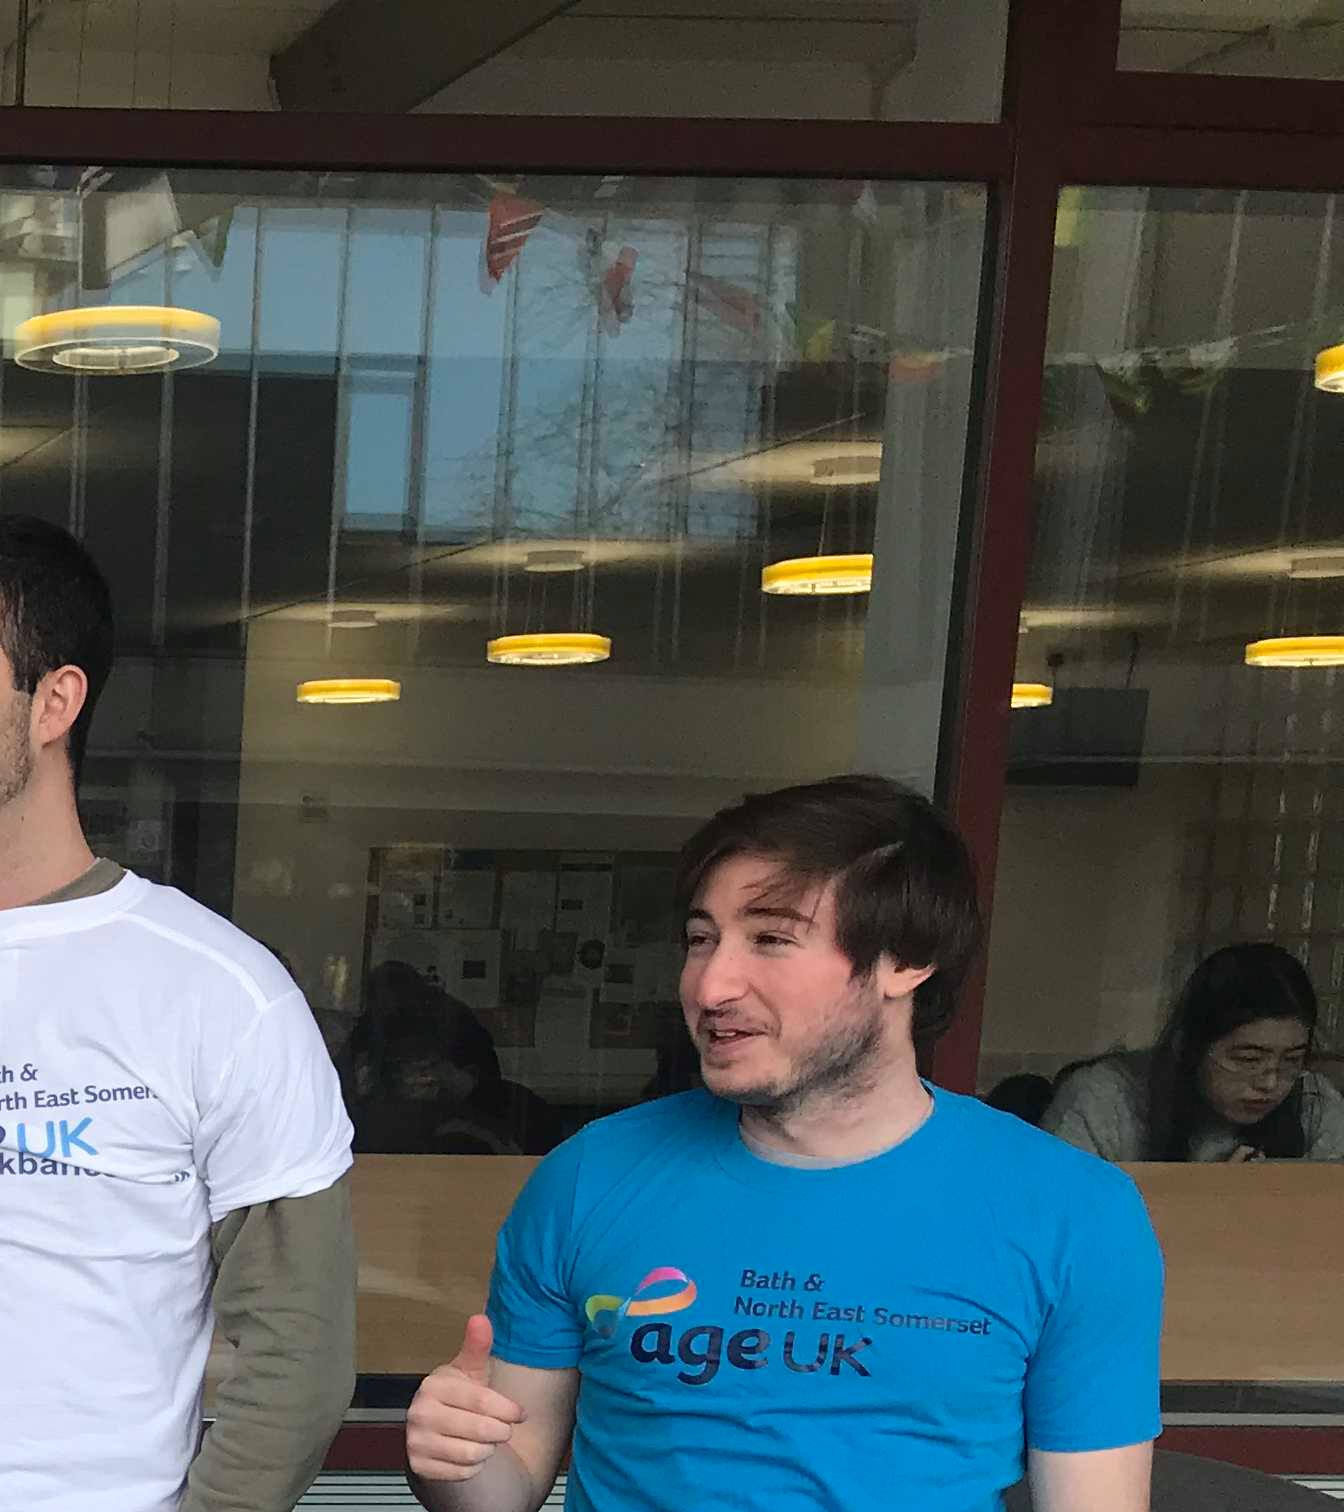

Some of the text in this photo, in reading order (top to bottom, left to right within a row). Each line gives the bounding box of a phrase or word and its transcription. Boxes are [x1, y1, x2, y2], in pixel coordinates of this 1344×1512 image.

[19, 1062, 39, 1082] &
[34, 1088, 80, 1107] East
[740, 1268, 825, 1293] Bath &
[734, 1295, 993, 1336] North East Somerset
[629, 1321, 873, 1387] age UK
